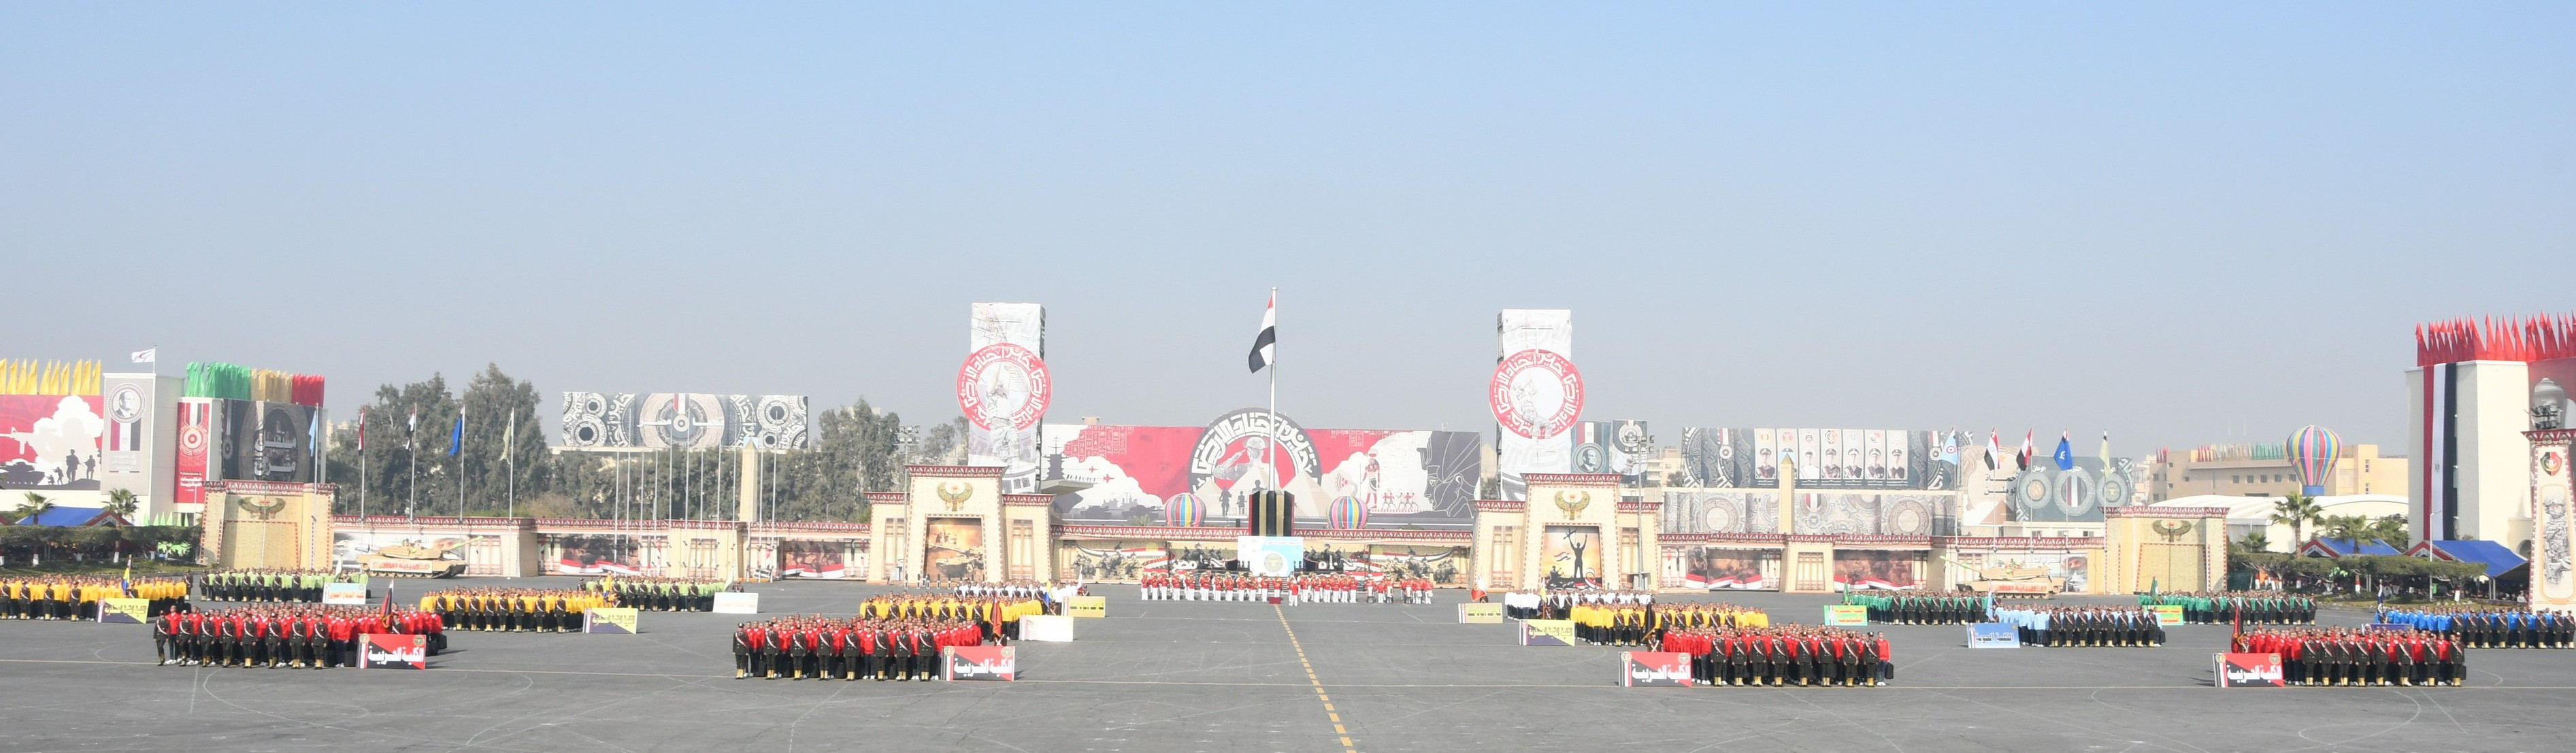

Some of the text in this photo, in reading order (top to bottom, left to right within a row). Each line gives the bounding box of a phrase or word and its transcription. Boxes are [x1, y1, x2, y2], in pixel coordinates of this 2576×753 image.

[367, 645, 425, 665] الكلية الحربية
[953, 657, 1012, 677] الكلية الحربية
[1632, 663, 1691, 683] الكلية الحربية
[2226, 665, 2283, 684] الكلية الحربية
